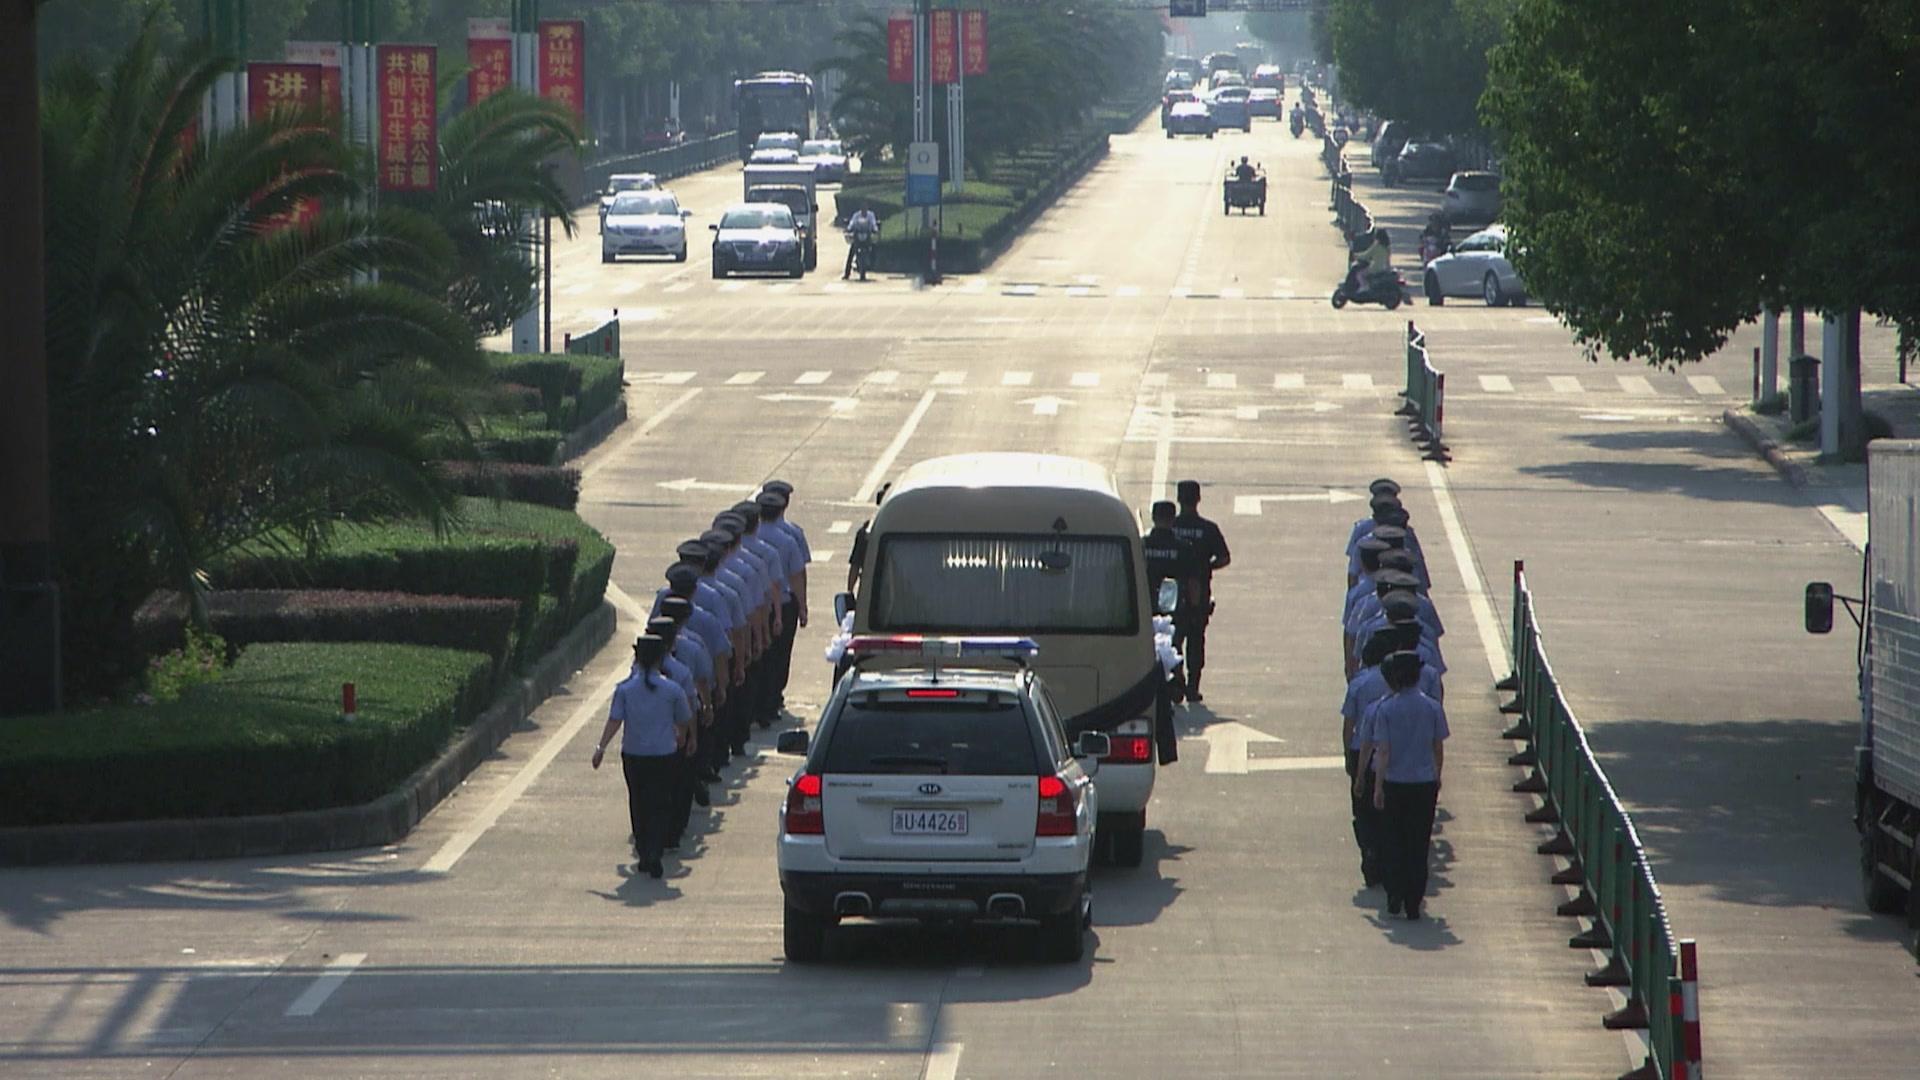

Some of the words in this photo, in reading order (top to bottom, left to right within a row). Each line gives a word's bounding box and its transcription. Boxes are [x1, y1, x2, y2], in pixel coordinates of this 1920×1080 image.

[386, 52, 407, 186] 共创卫生城市
[411, 52, 430, 186] 遵守社会公德
[920, 784, 942, 794] KIA
